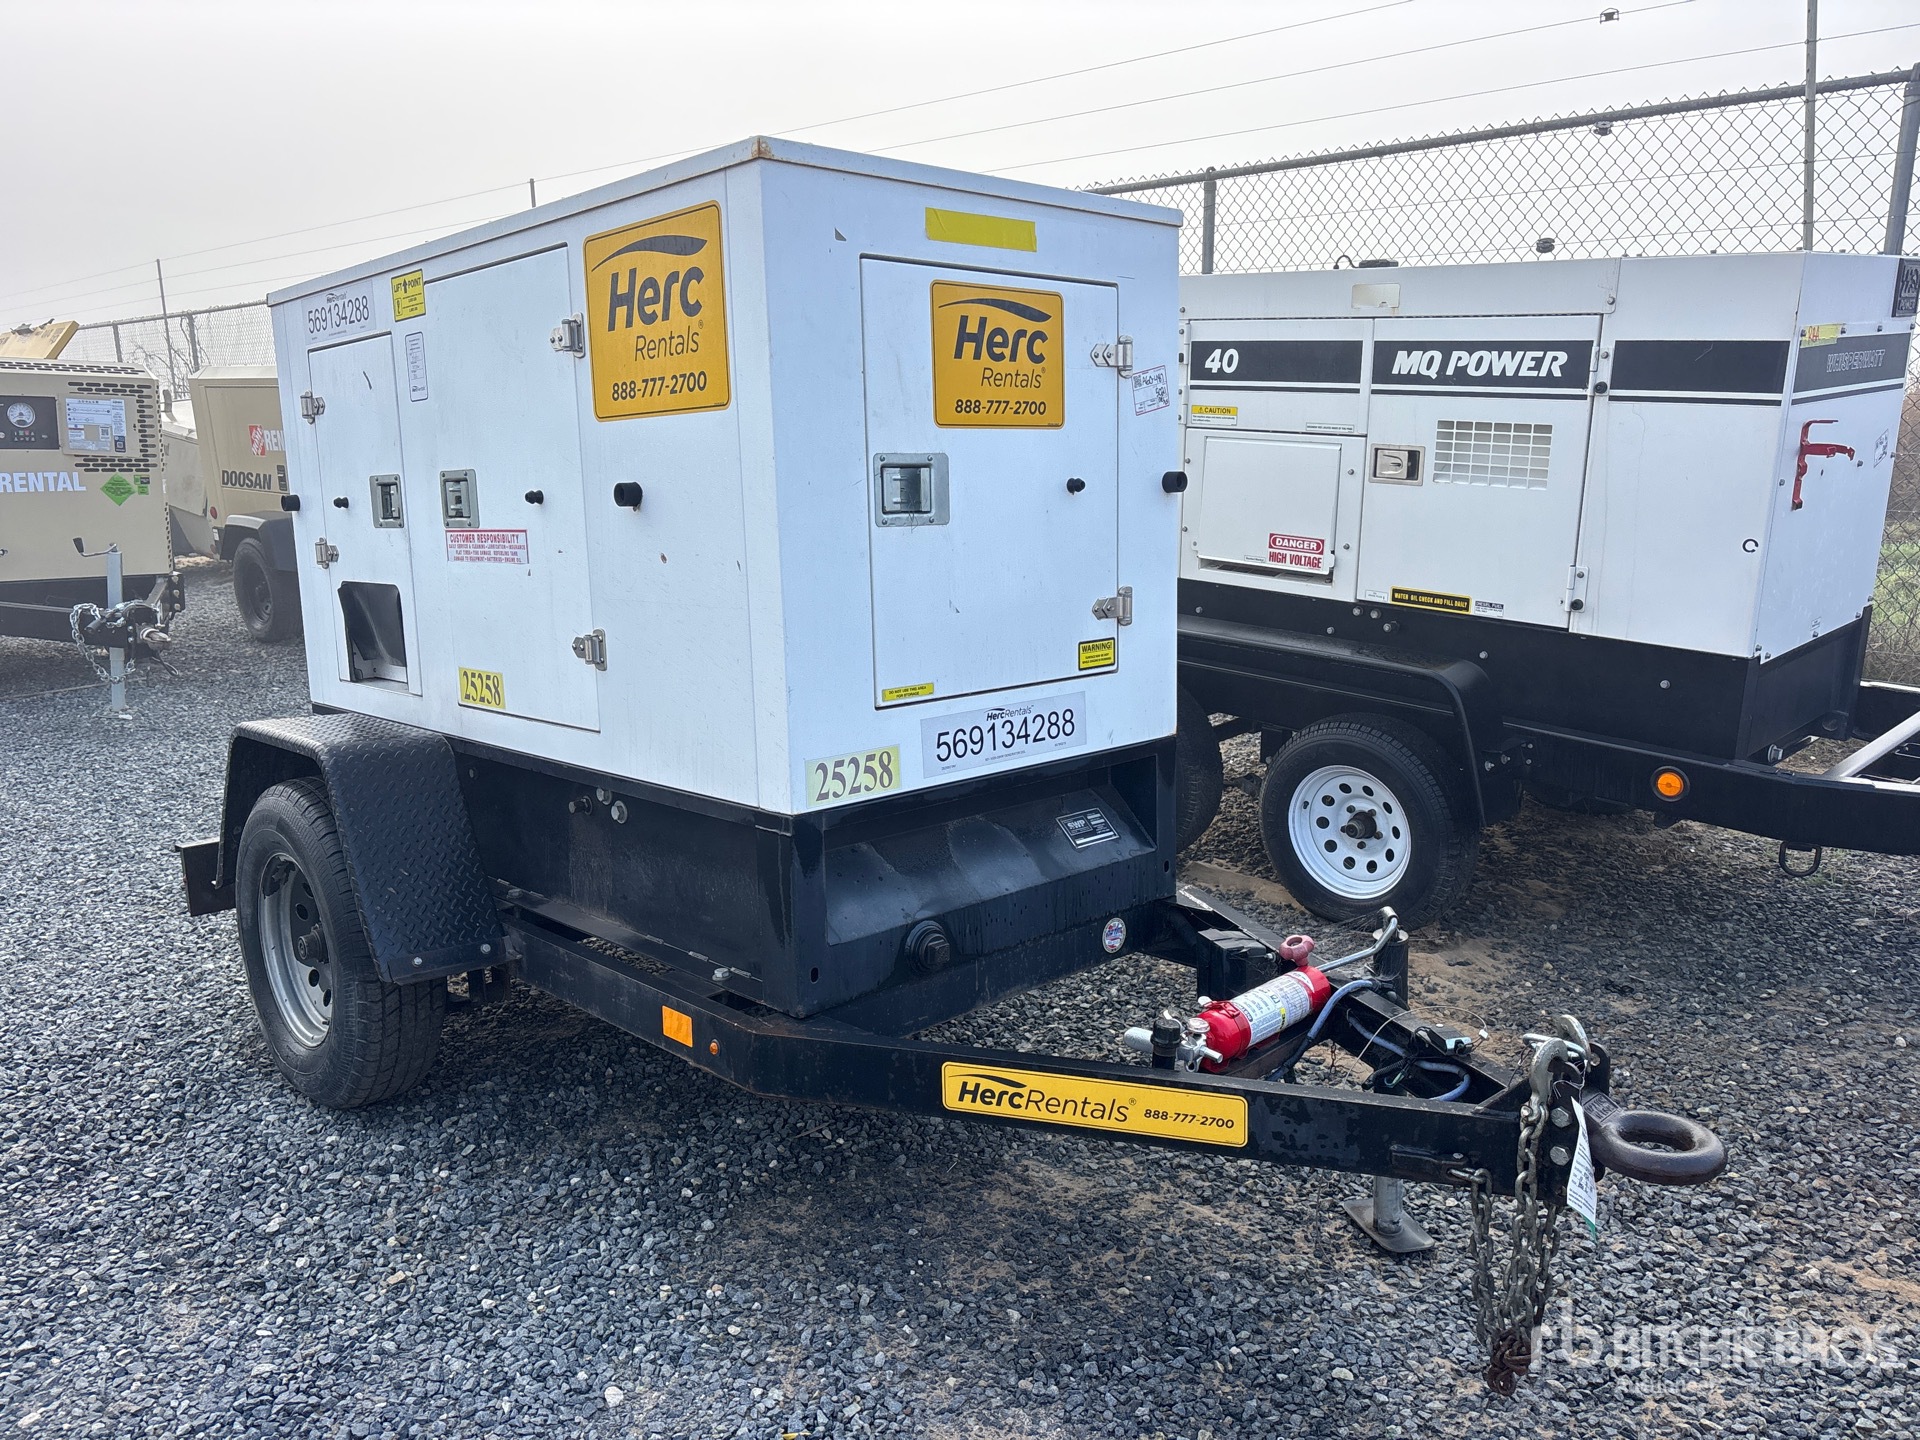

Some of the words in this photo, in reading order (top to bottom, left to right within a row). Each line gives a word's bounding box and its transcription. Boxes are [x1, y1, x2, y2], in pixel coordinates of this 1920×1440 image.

[394, 283, 402, 293] LIFT
[407, 277, 421, 289] POINT
[607, 266, 704, 332] Herc
[308, 295, 370, 334] 569134288
[953, 315, 1049, 364] Herc
[1204, 348, 1239, 373] 40
[1391, 350, 1442, 379] MQ
[1445, 350, 1568, 378] POWER
[611, 370, 707, 401] 888-777-2700
[954, 399, 1047, 415] 888-777-2700
[1204, 406, 1232, 415] CAUTION
[0, 472, 87, 493] RENTAL
[221, 470, 272, 490] DOOSAN
[450, 534, 475, 543] CUSTOMER
[477, 534, 519, 544] RESPONSIBILITY
[1275, 538, 1317, 551] DANGER
[1268, 551, 1287, 564] HIGH
[1289, 553, 1322, 569] VOLTAGE
[1394, 592, 1408, 600] WATER
[1419, 595, 1433, 603] CHECK
[1434, 597, 1443, 605] AND
[1444, 598, 1453, 606] FILL
[1454, 600, 1467, 608] DAILY
[463, 670, 501, 706] 25258
[986, 706, 1032, 721] HercRentals
[936, 708, 1076, 762] 569134288
[814, 750, 893, 802] 25258
[1143, 1109, 1235, 1129] 888-777-2700
